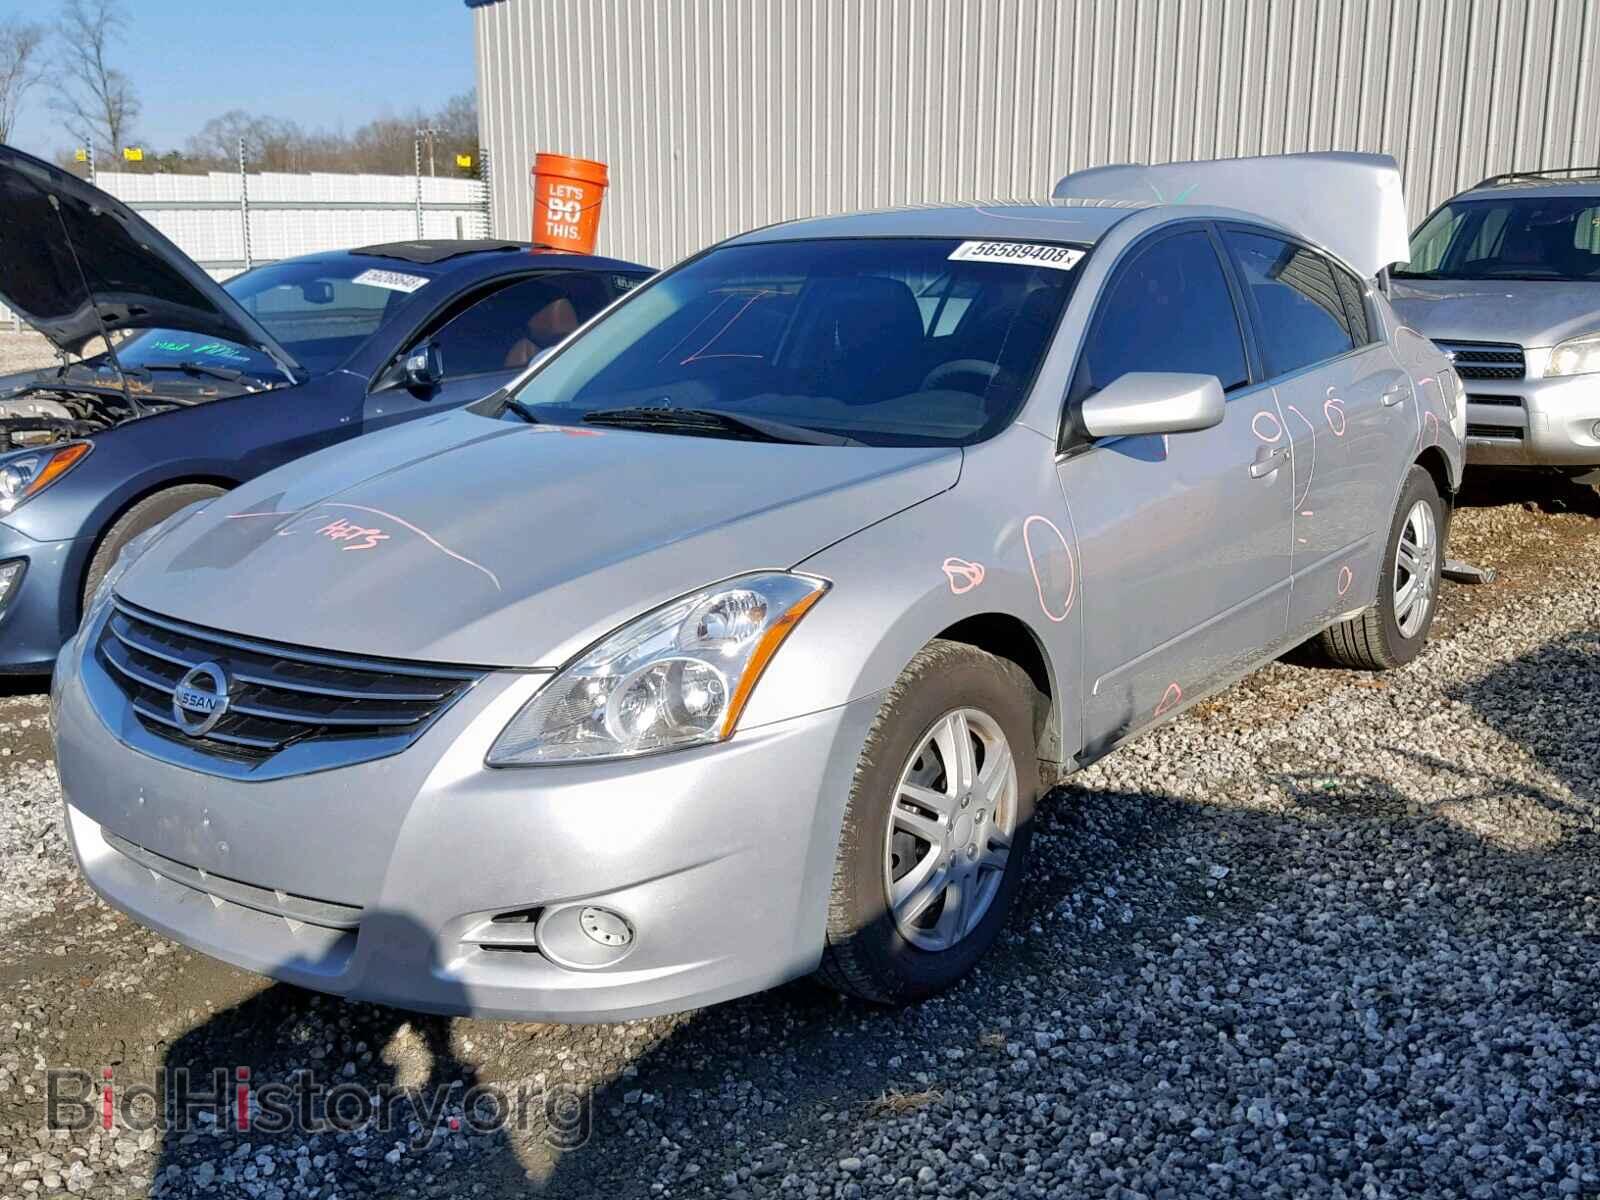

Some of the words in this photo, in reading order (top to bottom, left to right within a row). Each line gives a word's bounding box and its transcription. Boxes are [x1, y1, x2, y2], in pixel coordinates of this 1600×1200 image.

[547, 183, 584, 201] LET'S
[545, 221, 582, 241] THIS.
[176, 691, 217, 710] SSAN
